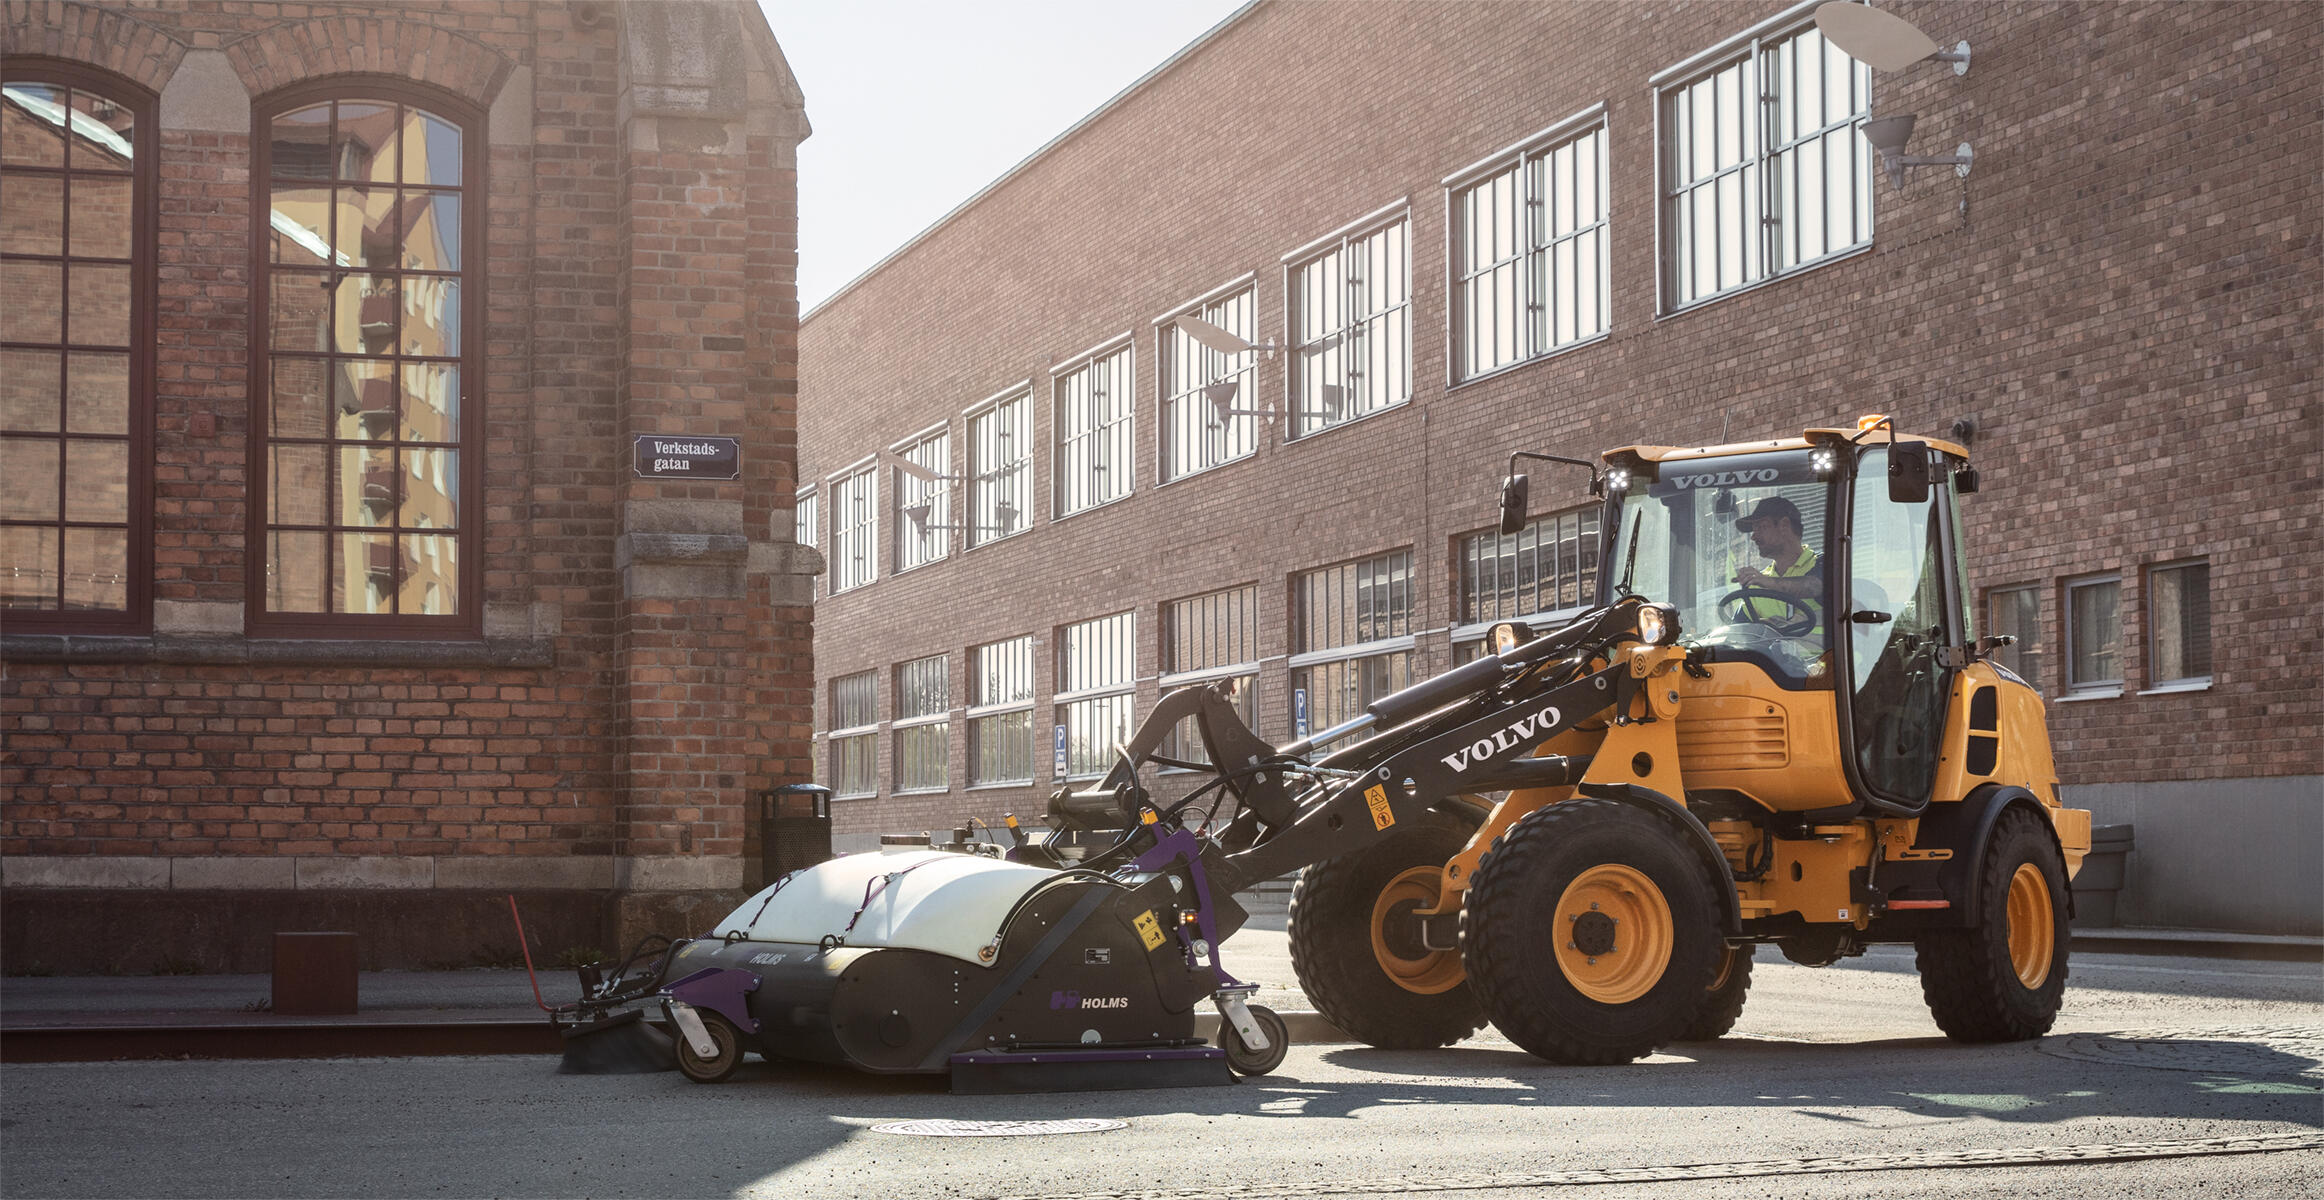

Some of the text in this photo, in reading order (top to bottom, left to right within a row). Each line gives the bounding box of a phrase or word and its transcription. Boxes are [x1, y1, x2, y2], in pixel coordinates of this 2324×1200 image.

[654, 441, 720, 455] Verkstads-
[654, 459, 690, 472] gatan
[1671, 468, 1779, 489] VOLVO
[1440, 706, 1561, 773] VOLVO
[1081, 997, 1128, 1009] HOLMS
